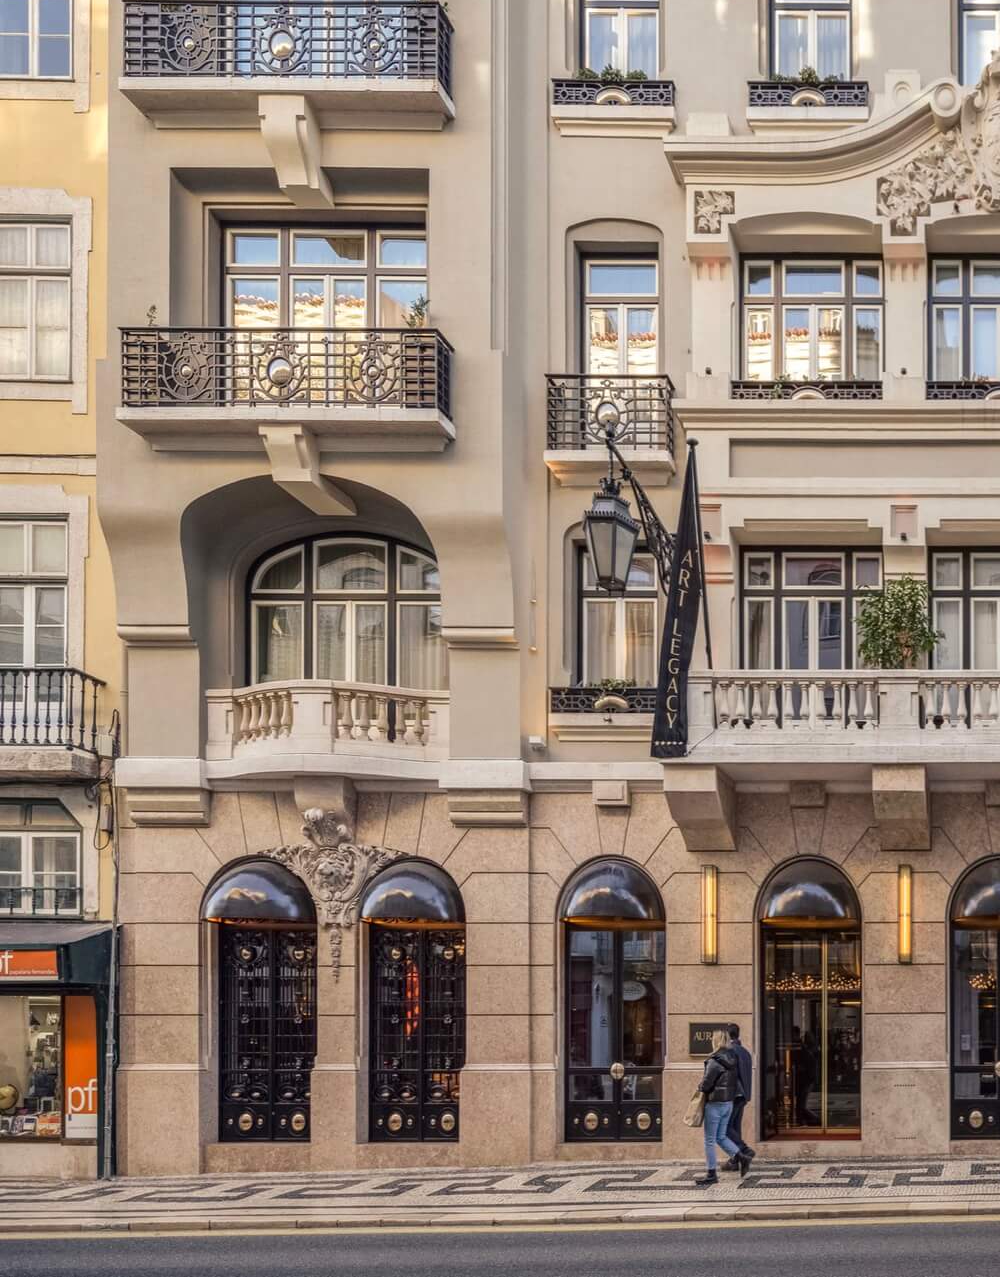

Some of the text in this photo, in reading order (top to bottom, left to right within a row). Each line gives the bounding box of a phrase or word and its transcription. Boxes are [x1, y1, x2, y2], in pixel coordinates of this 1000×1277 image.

[666, 549, 693, 729] ART LEGACY
[0, 949, 14, 975] f
